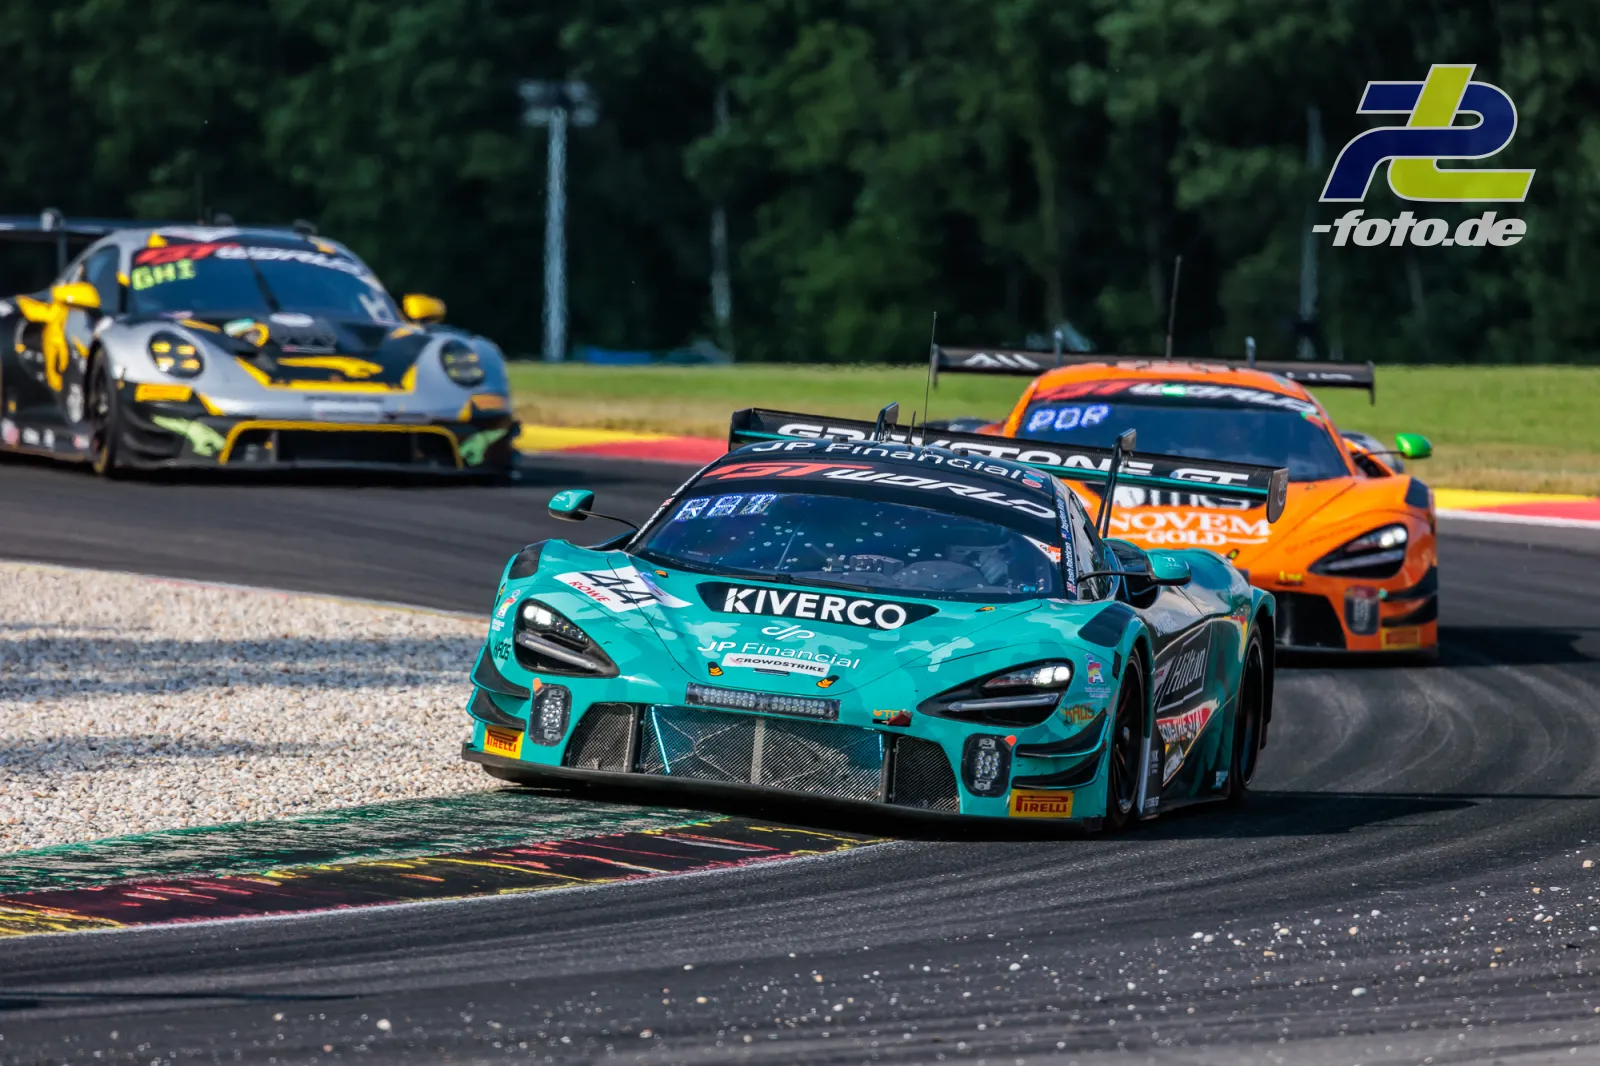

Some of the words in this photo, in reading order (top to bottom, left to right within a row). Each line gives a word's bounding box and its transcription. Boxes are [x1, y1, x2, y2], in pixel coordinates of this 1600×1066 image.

[132, 258, 196, 291] GHI
[1025, 402, 1111, 432] POR
[752, 442, 817, 452] JP
[825, 443, 1021, 479] Financial
[702, 462, 873, 480] GT
[823, 469, 1057, 519] WORLD
[1102, 510, 1272, 536] NOVEM
[1145, 529, 1227, 545] GOLD
[569, 581, 611, 603] ROWE
[579, 571, 663, 604] 44
[723, 587, 907, 630] KIVERCO
[697, 641, 737, 652] JP
[742, 641, 860, 669] Financial
[735, 656, 825, 674] CROWDSTRIKE
[1165, 648, 1206, 696] Hilton
[1015, 795, 1069, 813] PIRELLI
